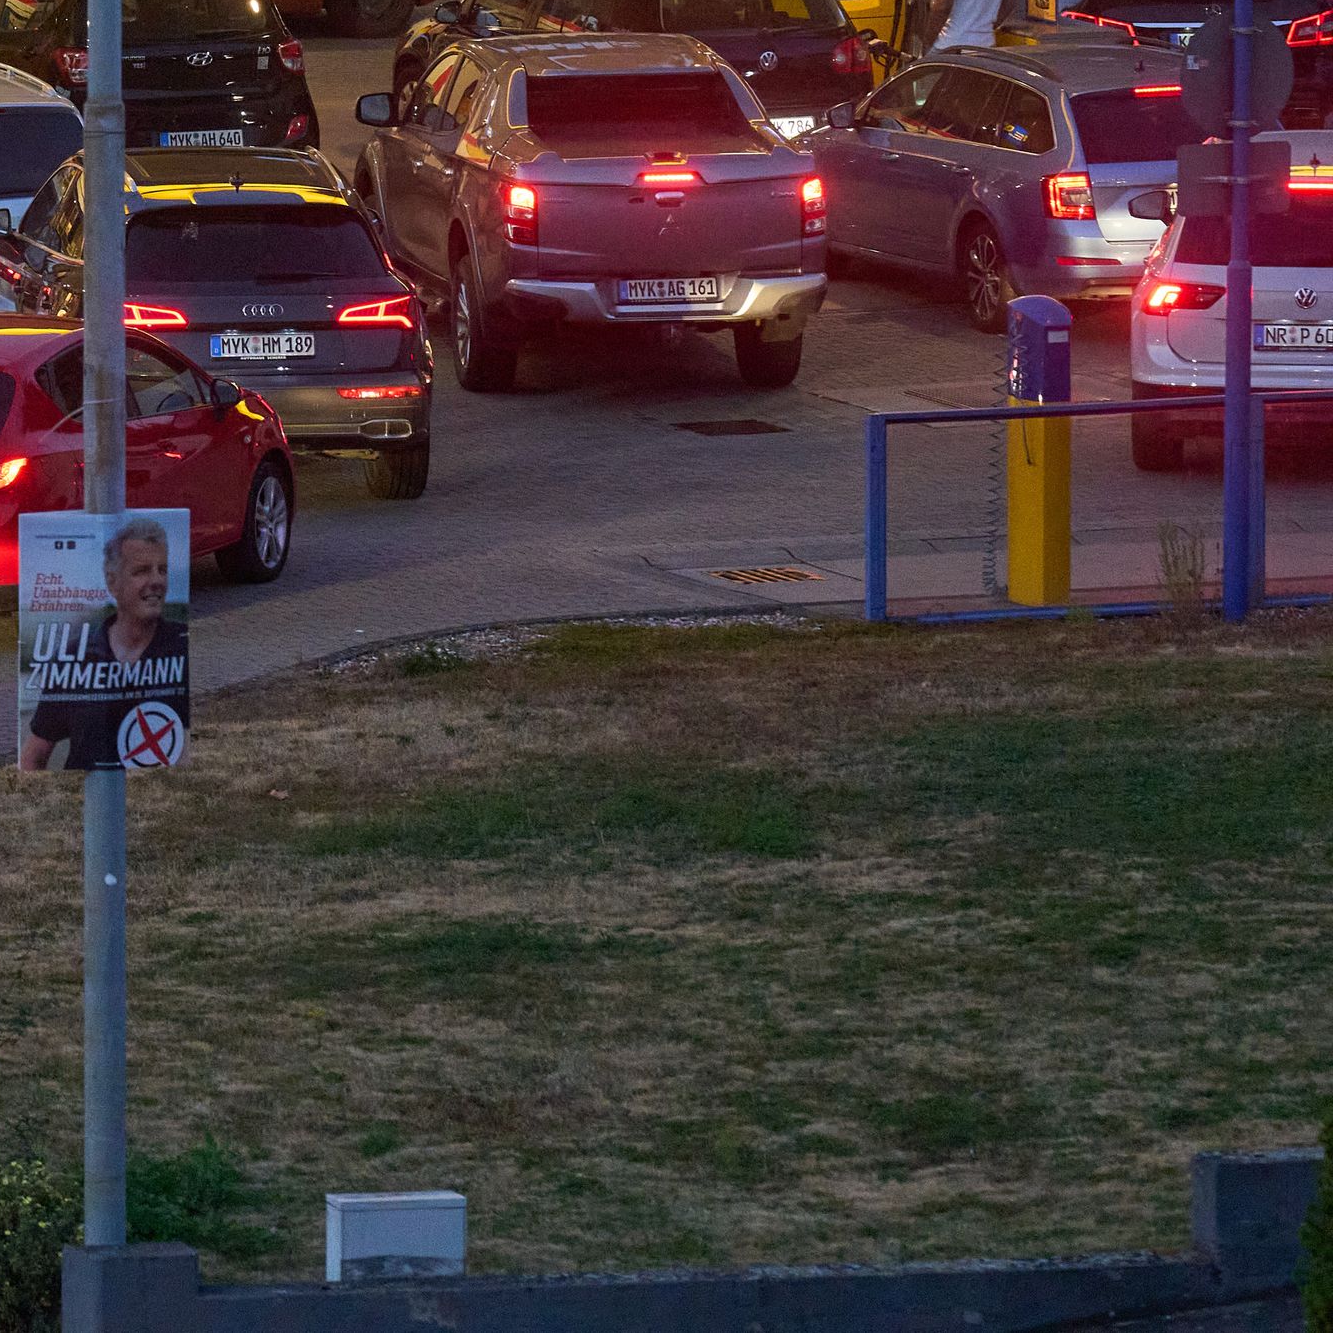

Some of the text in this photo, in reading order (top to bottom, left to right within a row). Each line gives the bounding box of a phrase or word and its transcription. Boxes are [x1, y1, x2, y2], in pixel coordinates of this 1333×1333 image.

[170, 131, 241, 147] MYK AH 640
[629, 280, 715, 298] MYK AG 161
[1266, 328, 1287, 343] NR
[1301, 328, 1310, 343] P
[221, 336, 312, 354] MYK HM 189
[35, 573, 65, 585] Echt.
[33, 622, 90, 662] ULI
[25, 655, 185, 690] ZIMMERMANN
